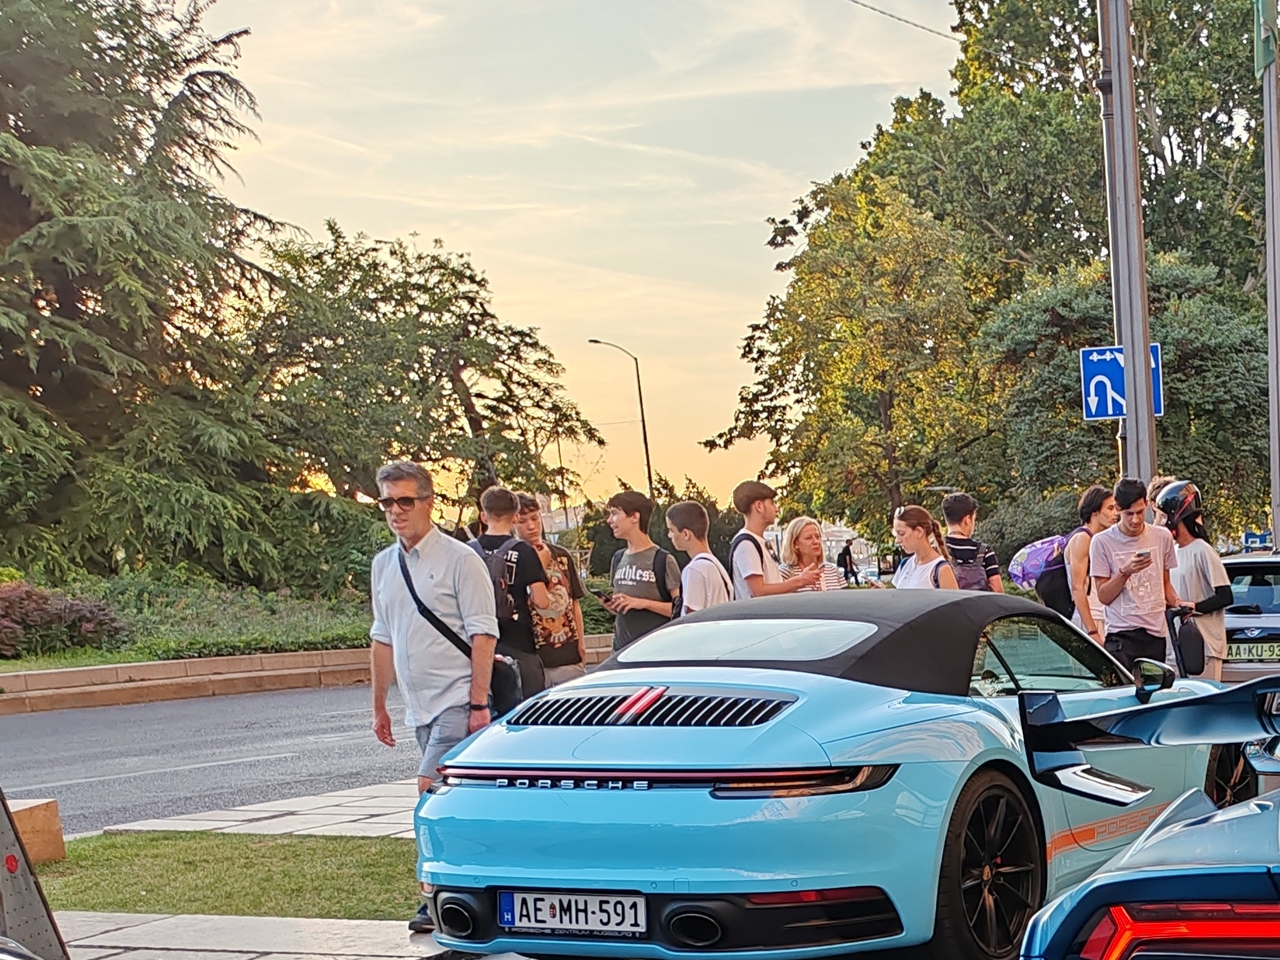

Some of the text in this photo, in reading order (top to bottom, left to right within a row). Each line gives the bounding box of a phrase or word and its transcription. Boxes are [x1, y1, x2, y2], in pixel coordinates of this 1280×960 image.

[496, 779, 649, 790] PORSCHE
[504, 912, 512, 922] H
[518, 896, 641, 928] AE MH-591
[554, 928, 590, 936] ZENTRUM
